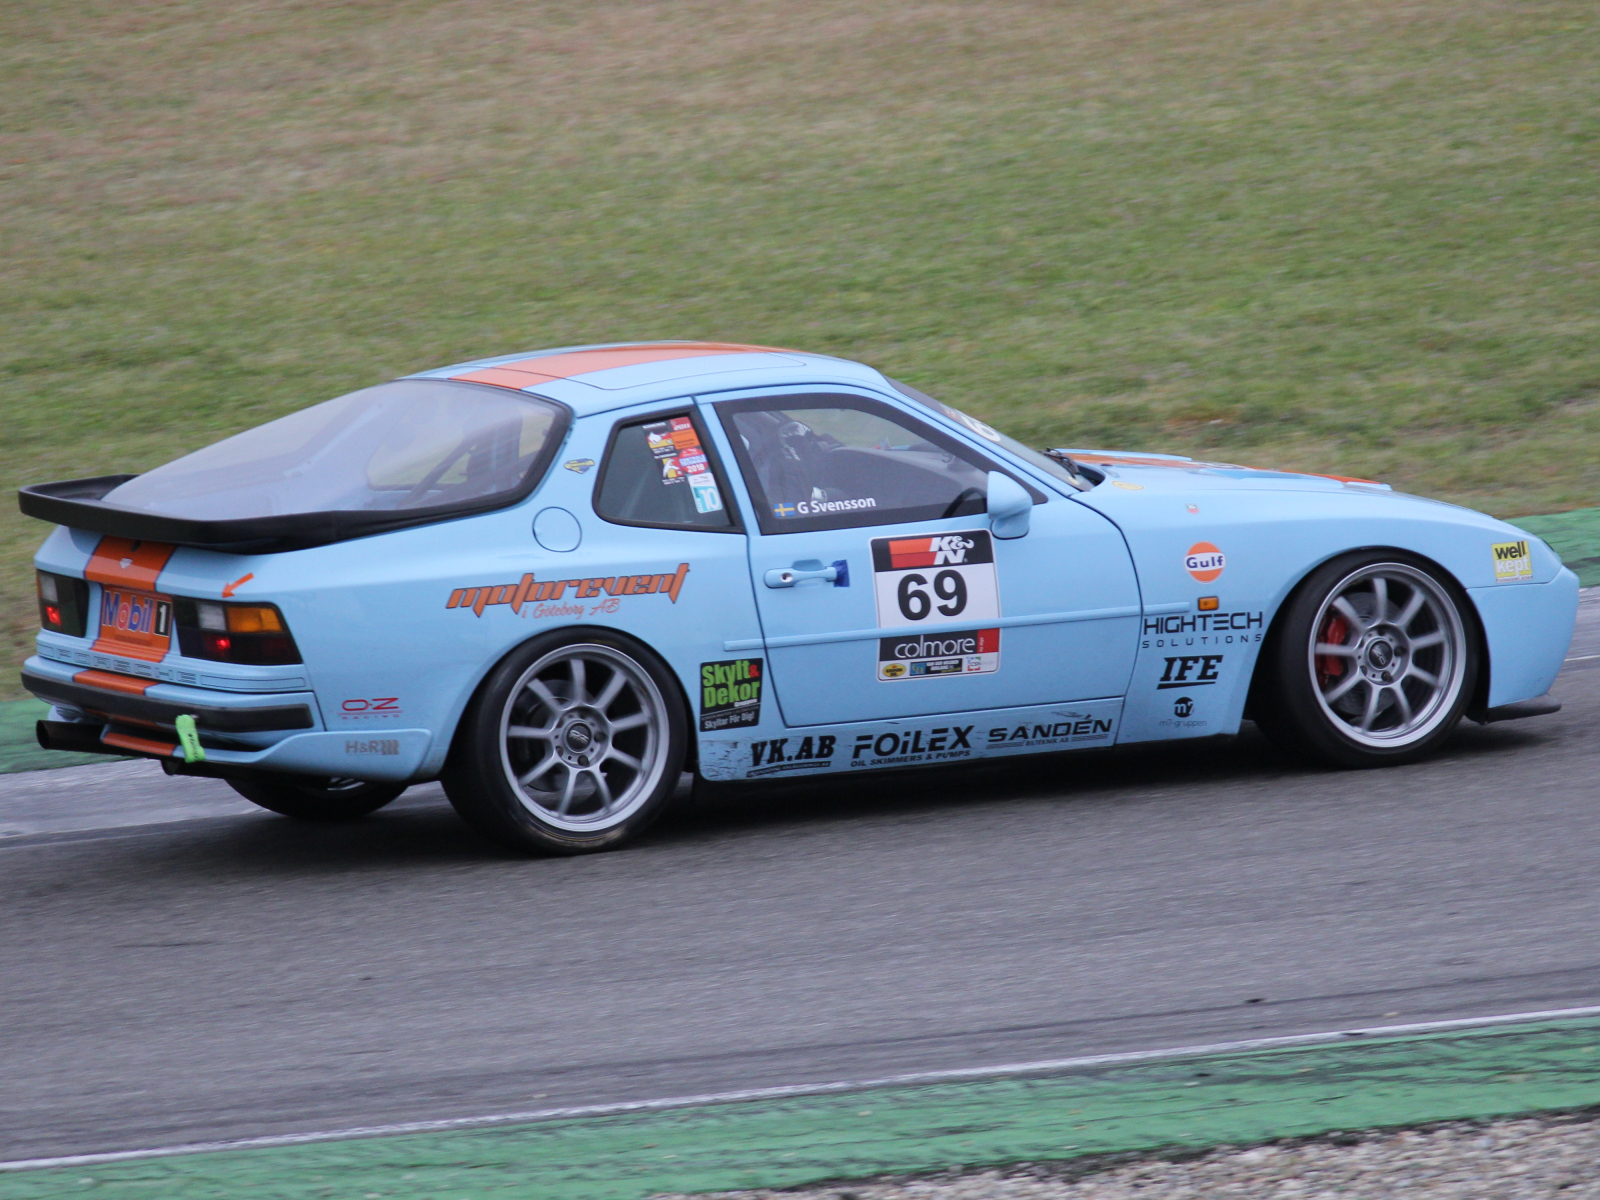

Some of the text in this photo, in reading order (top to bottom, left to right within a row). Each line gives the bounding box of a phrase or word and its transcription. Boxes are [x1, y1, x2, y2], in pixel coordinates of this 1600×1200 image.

[699, 487, 721, 510] 10
[797, 497, 876, 514] G Svensson
[1495, 541, 1526, 560] well
[1186, 556, 1224, 569] Gulf
[1496, 554, 1531, 577] kept
[446, 563, 690, 618] motorevent
[897, 569, 968, 621] 69
[102, 590, 154, 633] Mobil
[589, 598, 621, 616] AB
[1143, 611, 1263, 635] HIGHTECH
[894, 634, 976, 659] colmore
[1142, 633, 1262, 649] SOLUTIONS
[1159, 655, 1224, 682] IFE
[704, 681, 760, 708] Dekor
[987, 714, 1113, 743] SANDÉN
[345, 740, 380, 753] H&R
[751, 735, 837, 767] VK.AB
[850, 760, 867, 768] OIL
[869, 754, 922, 766] SKIMMERS
[935, 749, 971, 760] PUMPS
